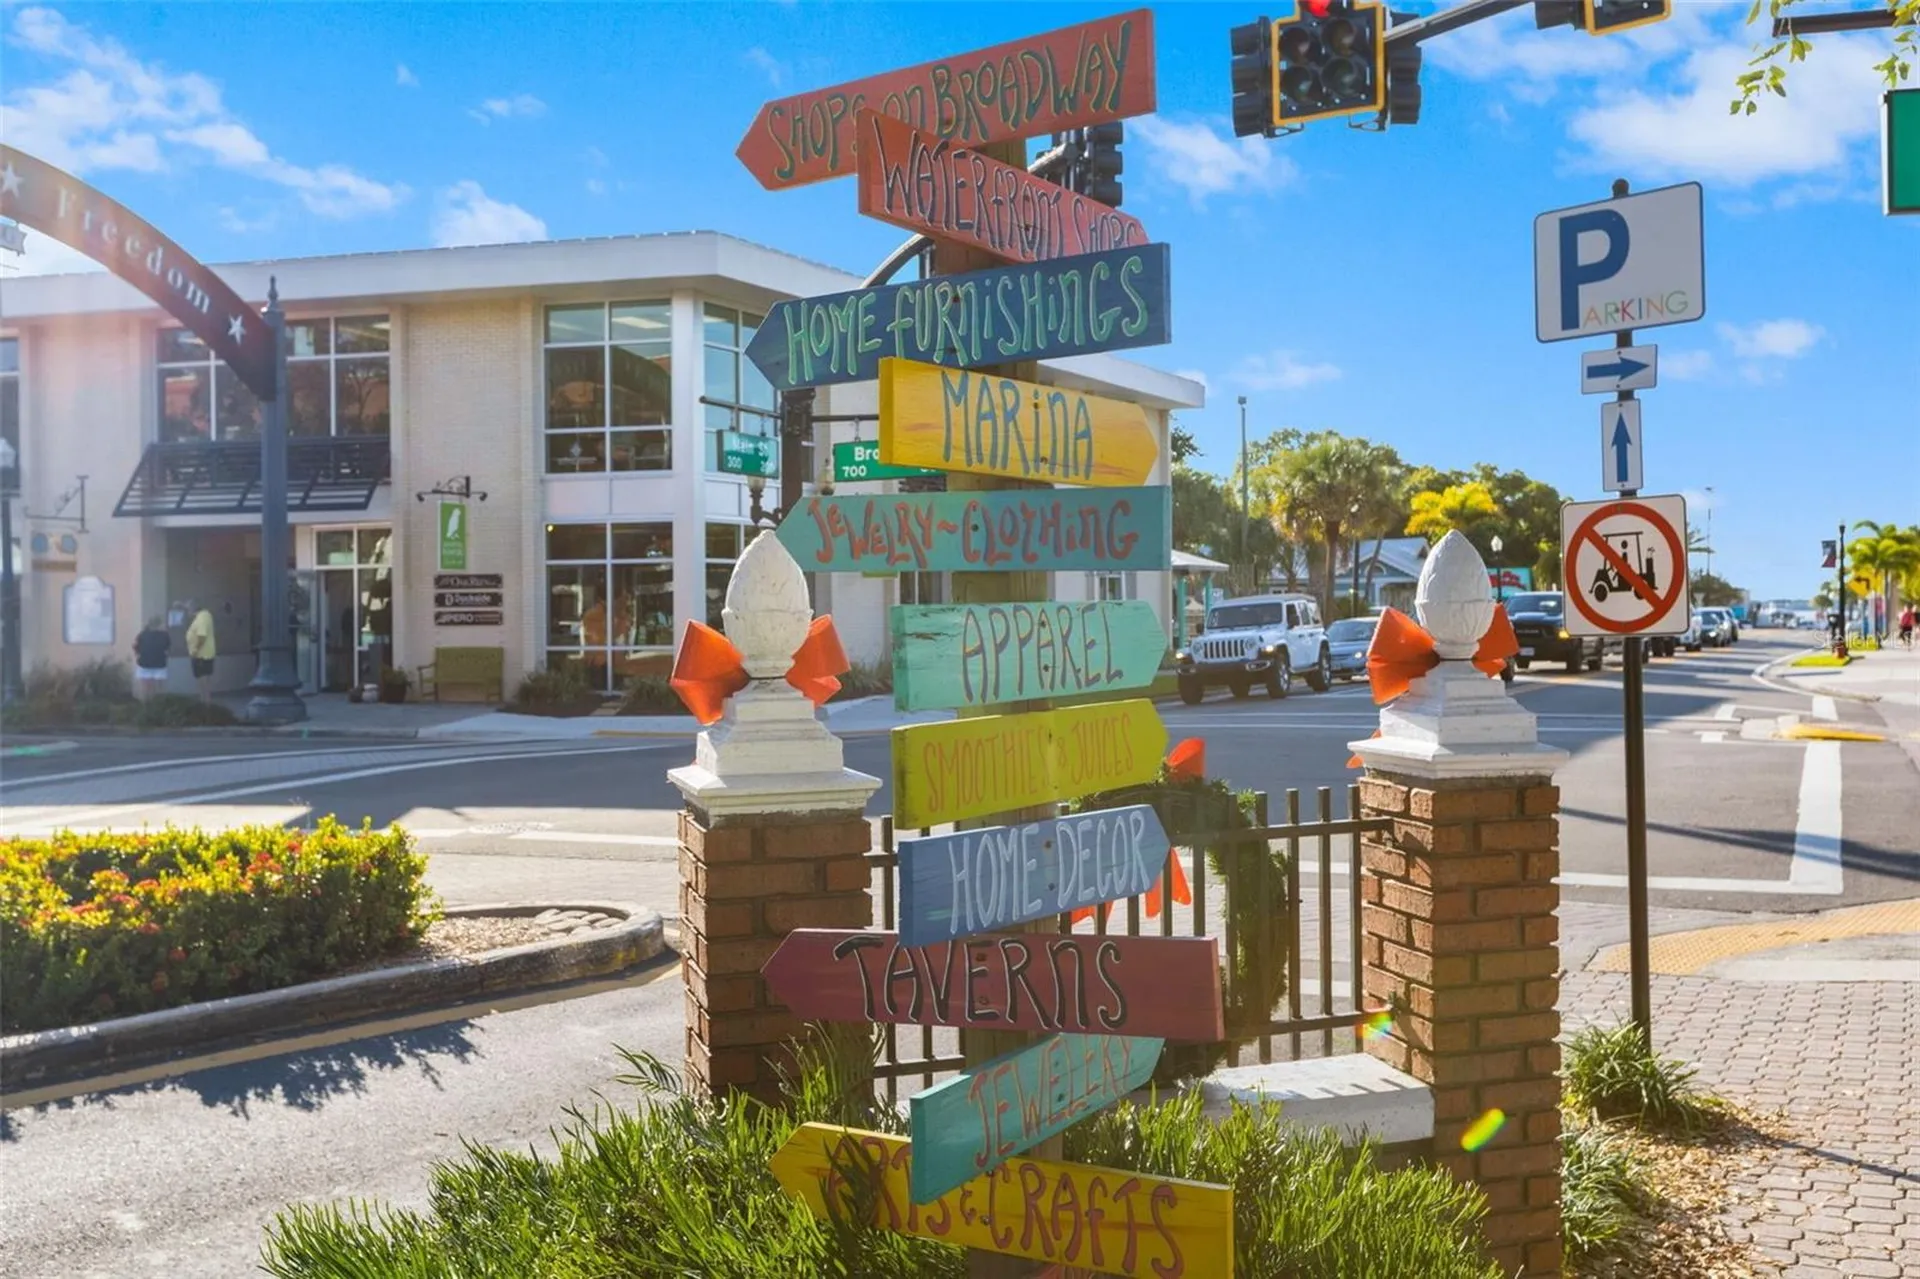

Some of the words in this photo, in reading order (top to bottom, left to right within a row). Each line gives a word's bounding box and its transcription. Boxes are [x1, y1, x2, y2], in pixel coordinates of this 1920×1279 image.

[930, 19, 1132, 143] BROADWAY
[58, 185, 211, 315] Freedom
[783, 291, 883, 385] HOME
[731, 435, 754, 454] Main
[842, 465, 867, 478] 700
[961, 604, 1125, 702] APPAREL
[922, 721, 1051, 813] SMOOTHIES
[1070, 711, 1135, 786] JUICES
[948, 822, 1044, 935] HOME
[1055, 809, 1154, 909] DECOR
